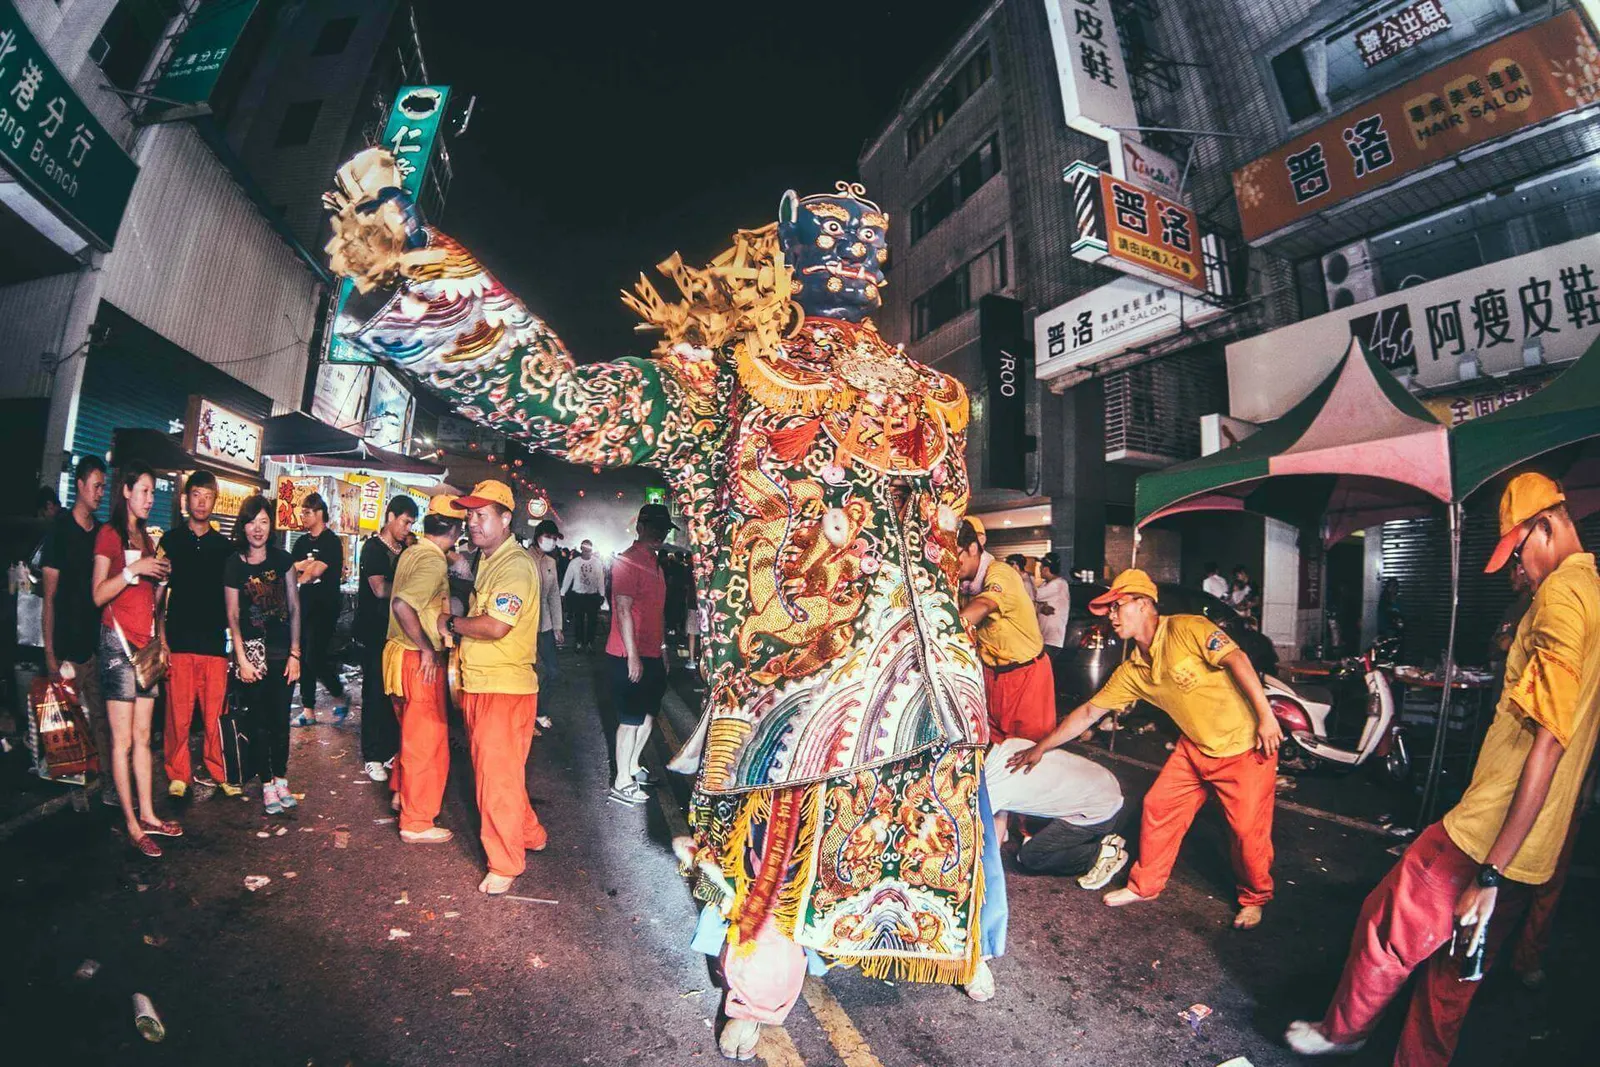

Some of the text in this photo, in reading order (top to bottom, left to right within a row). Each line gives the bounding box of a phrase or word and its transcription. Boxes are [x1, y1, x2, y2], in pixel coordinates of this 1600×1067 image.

[1074, 0, 1118, 90] 皮鞋
[1416, 84, 1533, 143] HAIR SALON
[30, 139, 79, 198] Branch
[1285, 113, 1395, 205] 普洛
[1110, 183, 1193, 254] 普洛
[1047, 310, 1094, 358] 普洛
[1101, 303, 1168, 337] HAIR SALON
[1424, 263, 1600, 361] 阿瘦皮鞋
[361, 480, 382, 521] 金桔
